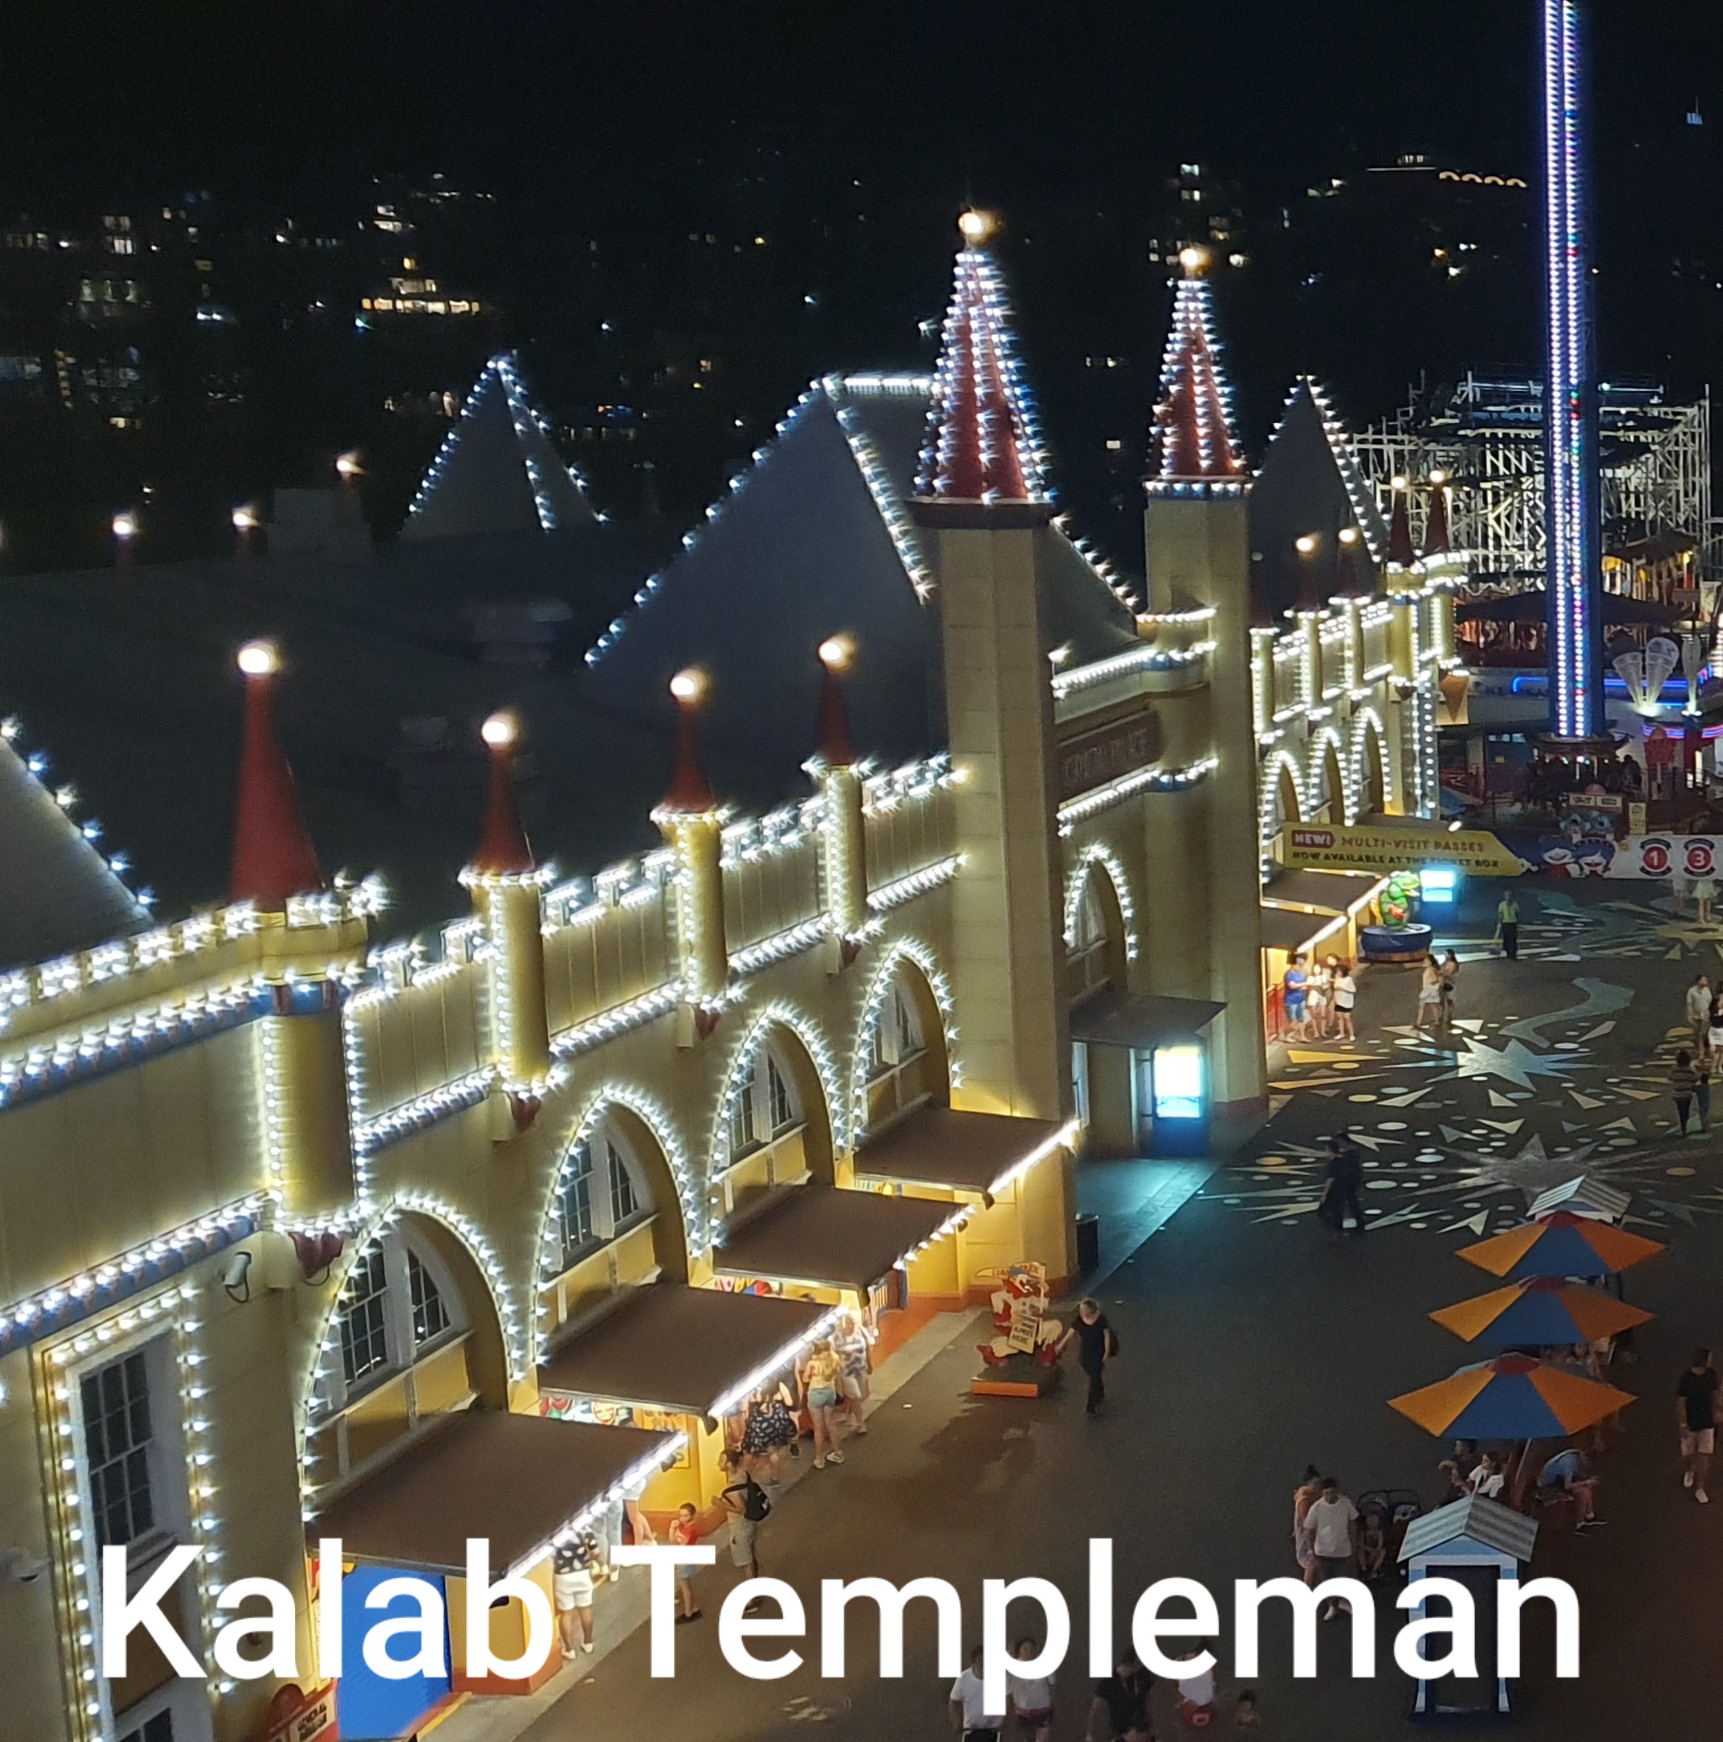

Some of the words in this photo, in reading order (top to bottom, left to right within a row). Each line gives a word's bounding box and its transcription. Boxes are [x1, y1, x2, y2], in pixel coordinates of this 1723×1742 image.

[1294, 833, 1332, 846] NEW!
[1341, 836, 1431, 851] MULTI-VISIT
[1433, 839, 1485, 852] PASSES
[1292, 851, 1321, 860] NOW
[1325, 852, 1385, 864] AVAILABLE
[1388, 854, 1403, 864] AT
[1475, 859, 1499, 868] BOX
[1649, 851, 1659, 866] 1
[1694, 851, 1705, 866] 3
